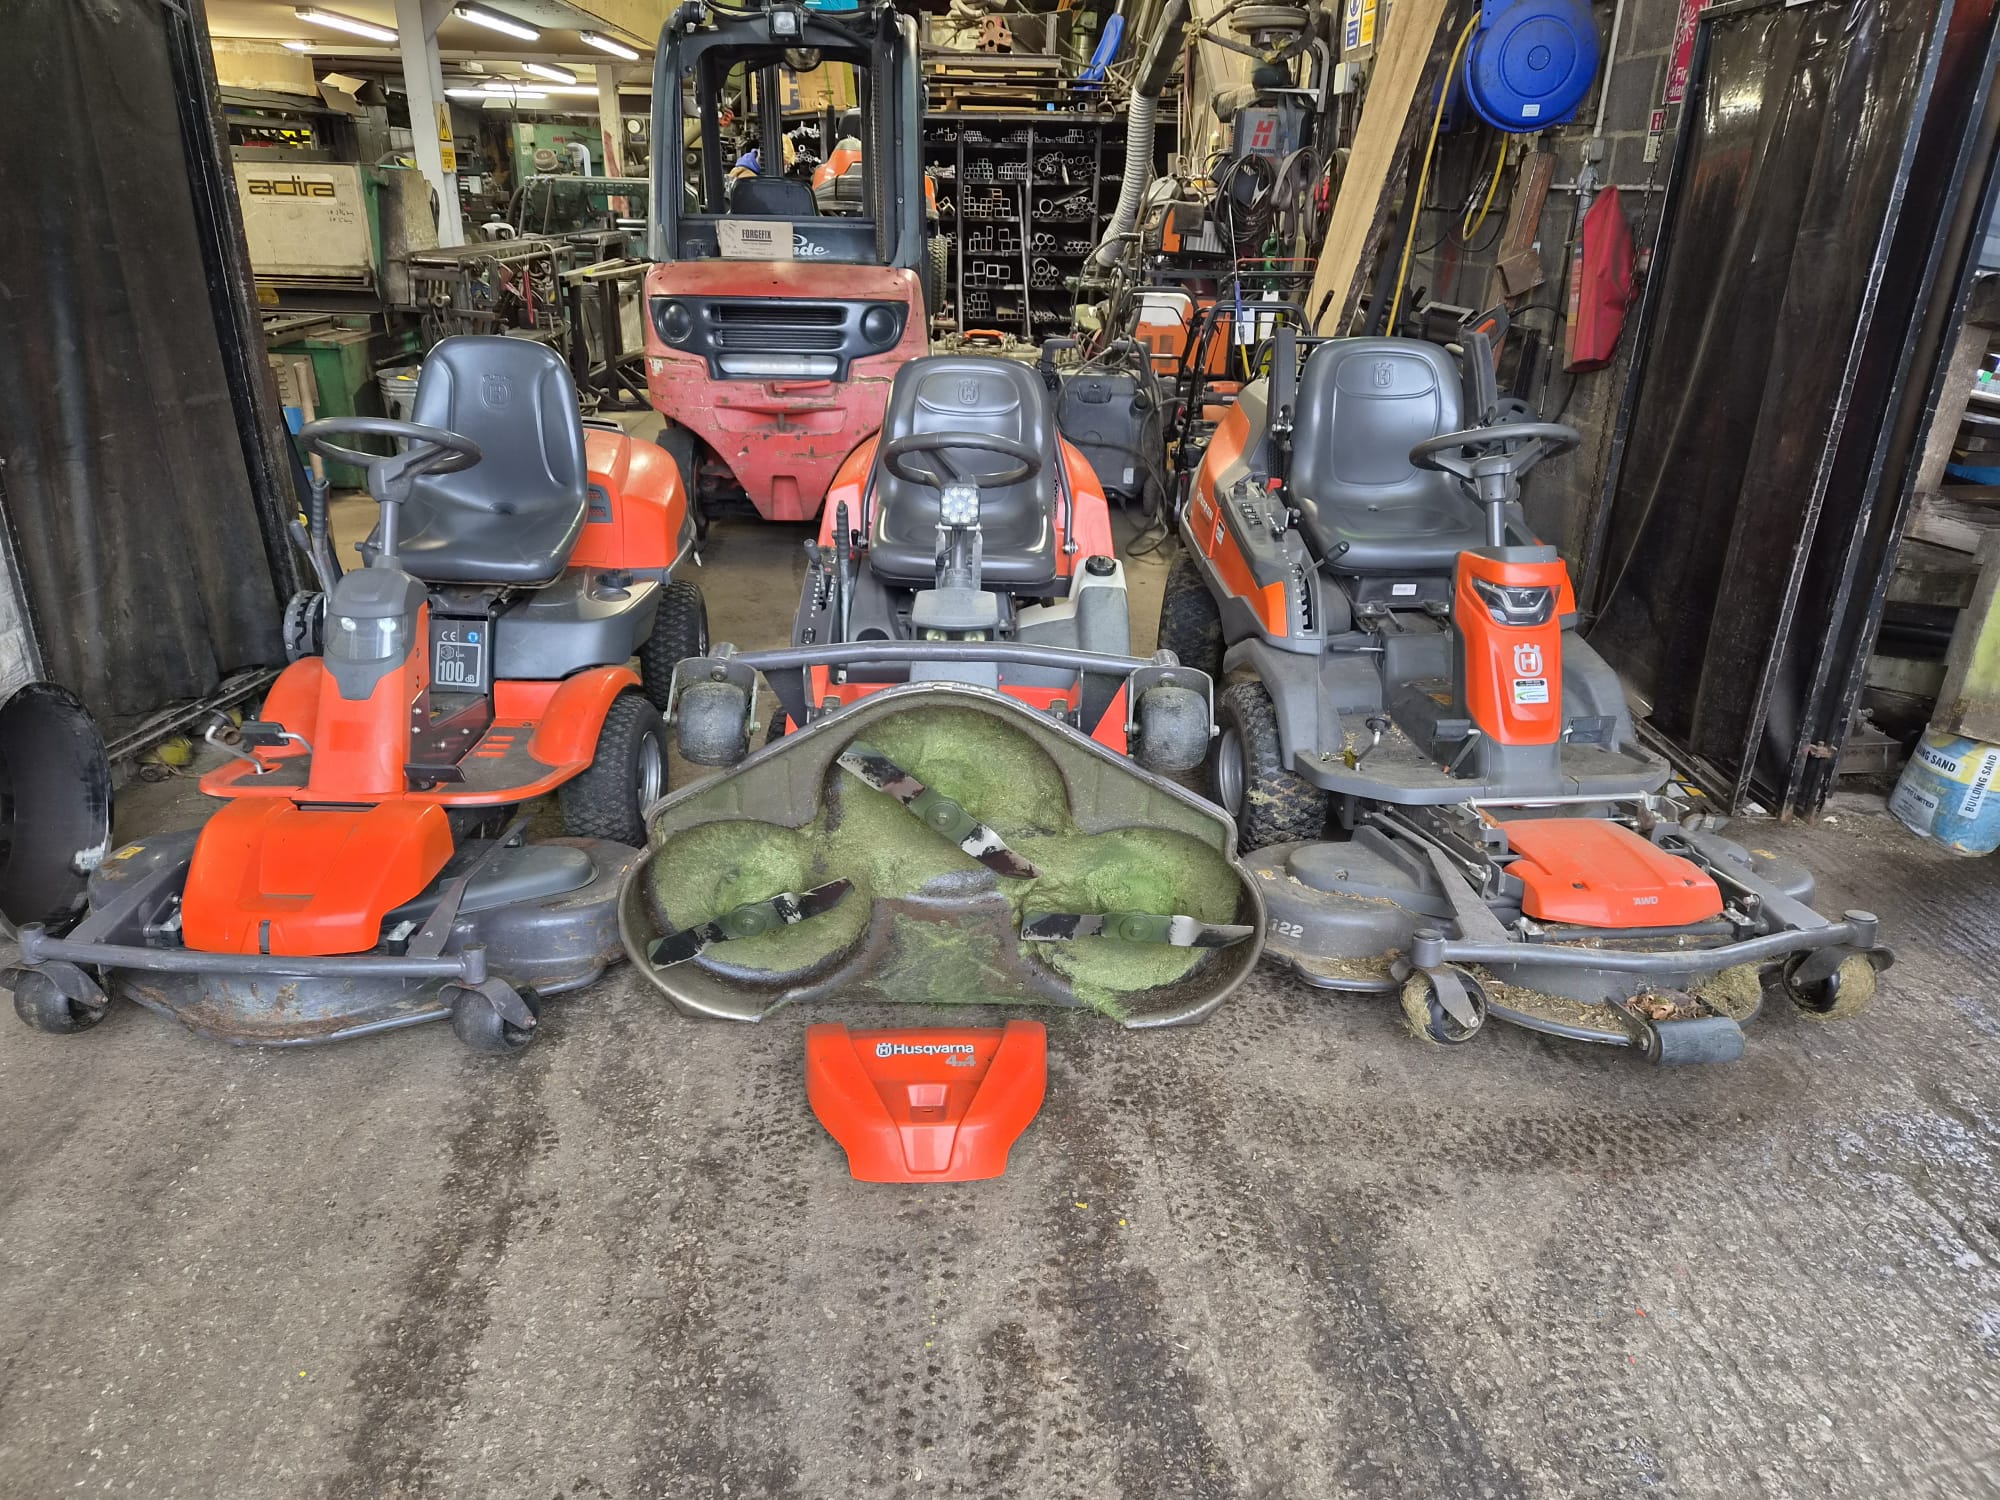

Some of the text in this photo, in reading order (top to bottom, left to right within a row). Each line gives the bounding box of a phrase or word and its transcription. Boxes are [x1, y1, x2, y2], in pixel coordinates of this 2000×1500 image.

[247, 175, 336, 198] adira
[741, 229, 772, 239] FORGEFIX
[440, 660, 475, 683] 100 dB
[1931, 753, 1957, 773] SAND
[1964, 754, 1998, 813] BUILDING SAND
[1634, 896, 1659, 906] AWD
[1271, 918, 1304, 938] 122
[893, 1043, 974, 1056] Husqvarna
